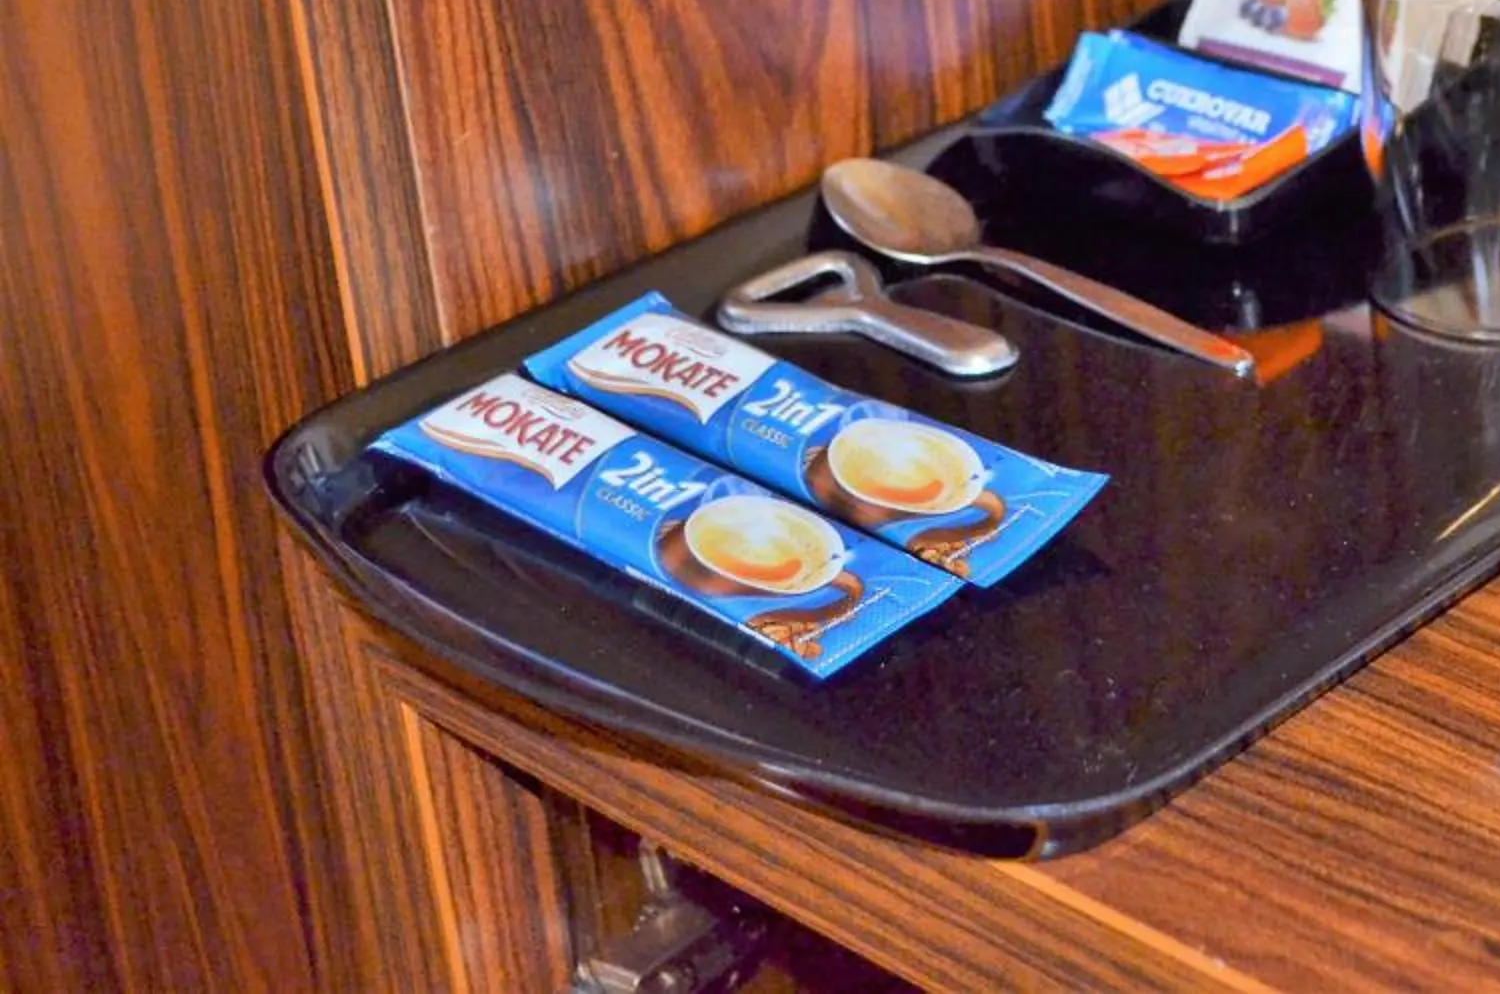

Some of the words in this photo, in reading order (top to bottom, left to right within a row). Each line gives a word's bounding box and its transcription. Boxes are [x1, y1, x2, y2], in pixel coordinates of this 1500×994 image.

[602, 329, 740, 399] MOKATE
[456, 392, 597, 466] MOKATE
[741, 417, 795, 449] CLASSIC
[742, 379, 844, 436] 2in1
[596, 487, 653, 523] CLASSIC
[599, 450, 708, 511] 2in1
